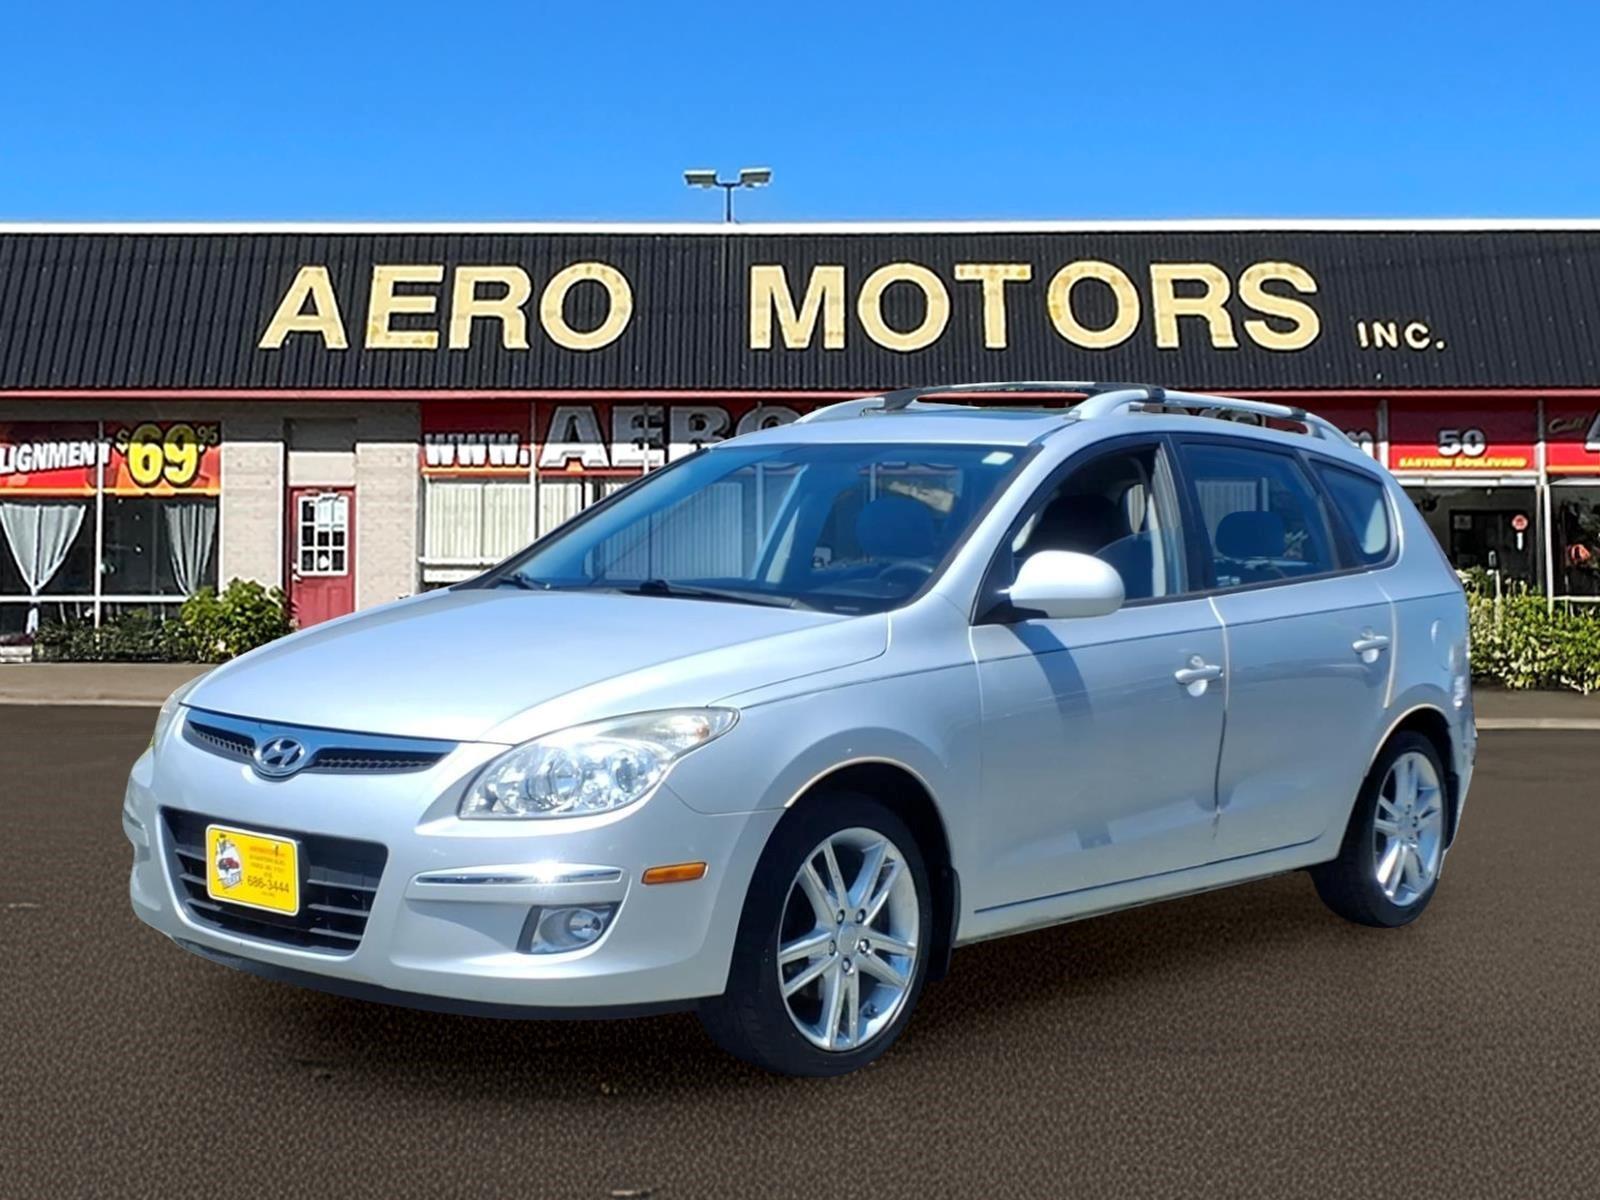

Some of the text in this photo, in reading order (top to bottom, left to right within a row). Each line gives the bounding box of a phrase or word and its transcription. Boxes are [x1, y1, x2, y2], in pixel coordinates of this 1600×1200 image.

[257, 260, 1447, 352] AERO MOTORS INC.
[1437, 429, 1486, 456] 50
